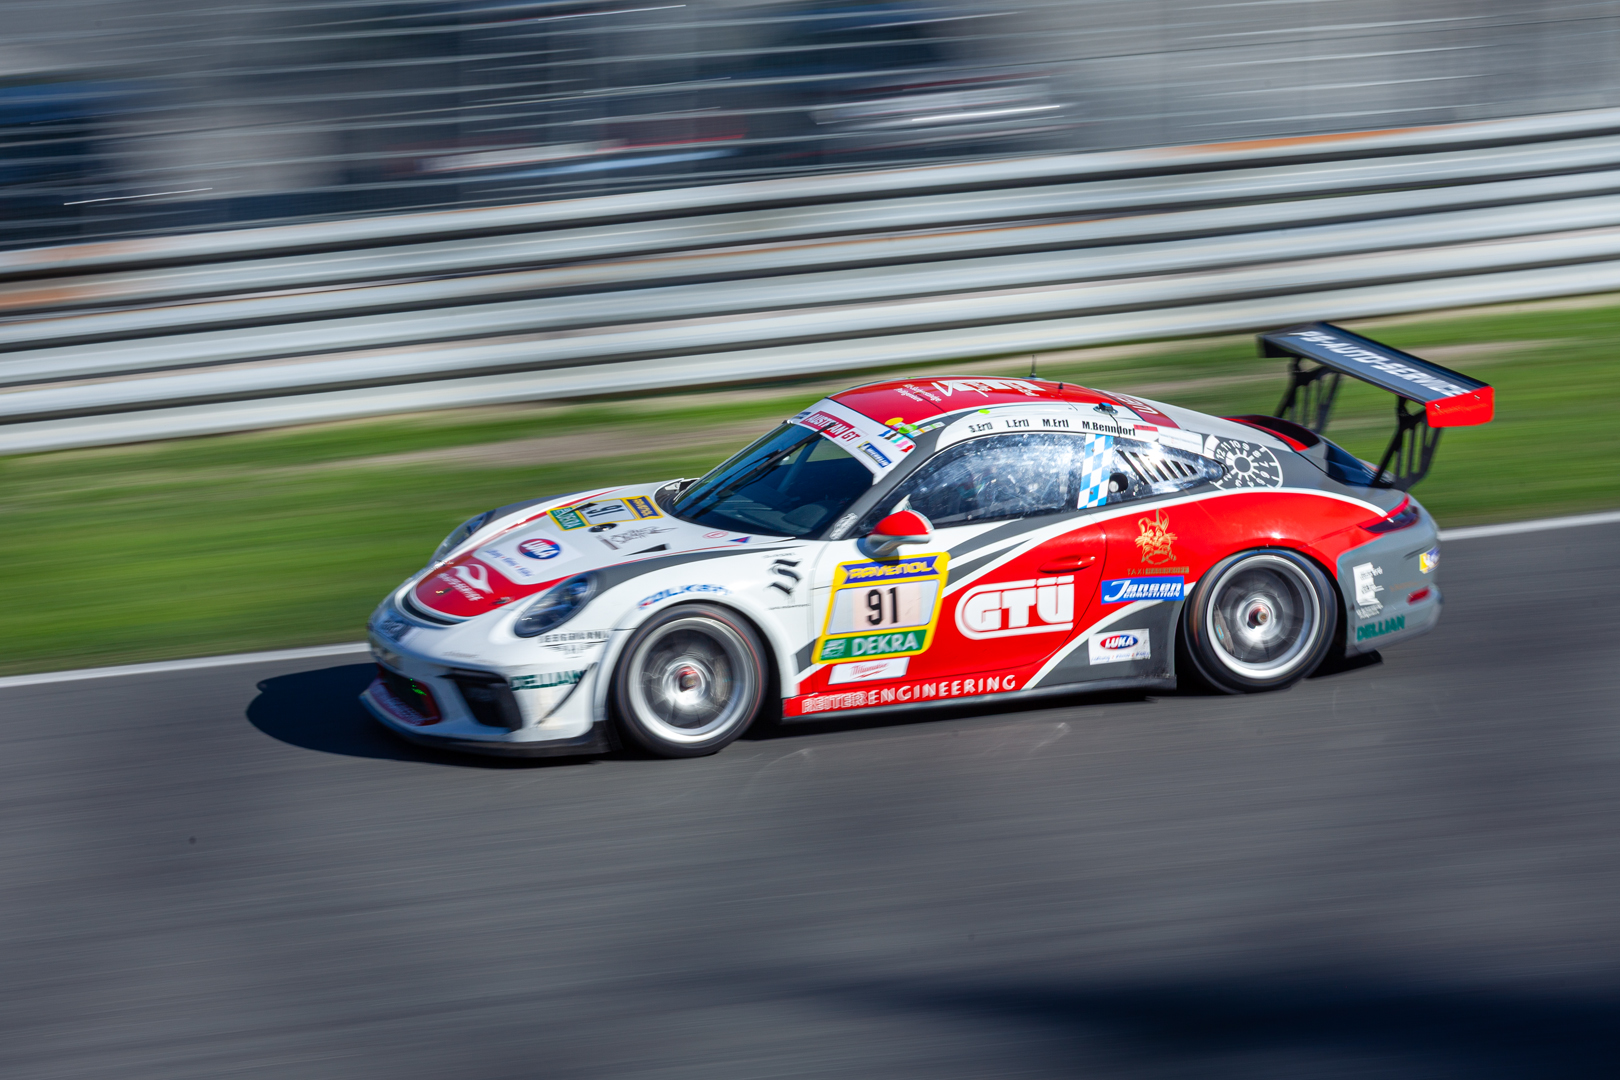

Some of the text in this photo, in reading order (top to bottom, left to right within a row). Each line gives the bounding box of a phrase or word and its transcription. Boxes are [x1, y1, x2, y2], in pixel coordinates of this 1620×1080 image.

[1288, 330, 1472, 397] PS-AUTO-SERVICE
[969, 421, 993, 433] S.Ertl
[1006, 419, 1030, 428] L.Ertl
[1042, 418, 1069, 428] M.Ertl
[841, 431, 861, 442] GT
[521, 540, 559, 558] LUKA
[849, 561, 933, 580] RAVENOL
[866, 586, 899, 627] 91
[956, 575, 1075, 639] GTÜ
[851, 632, 920, 657] DEKRA
[1104, 636, 1134, 649] LUKA
